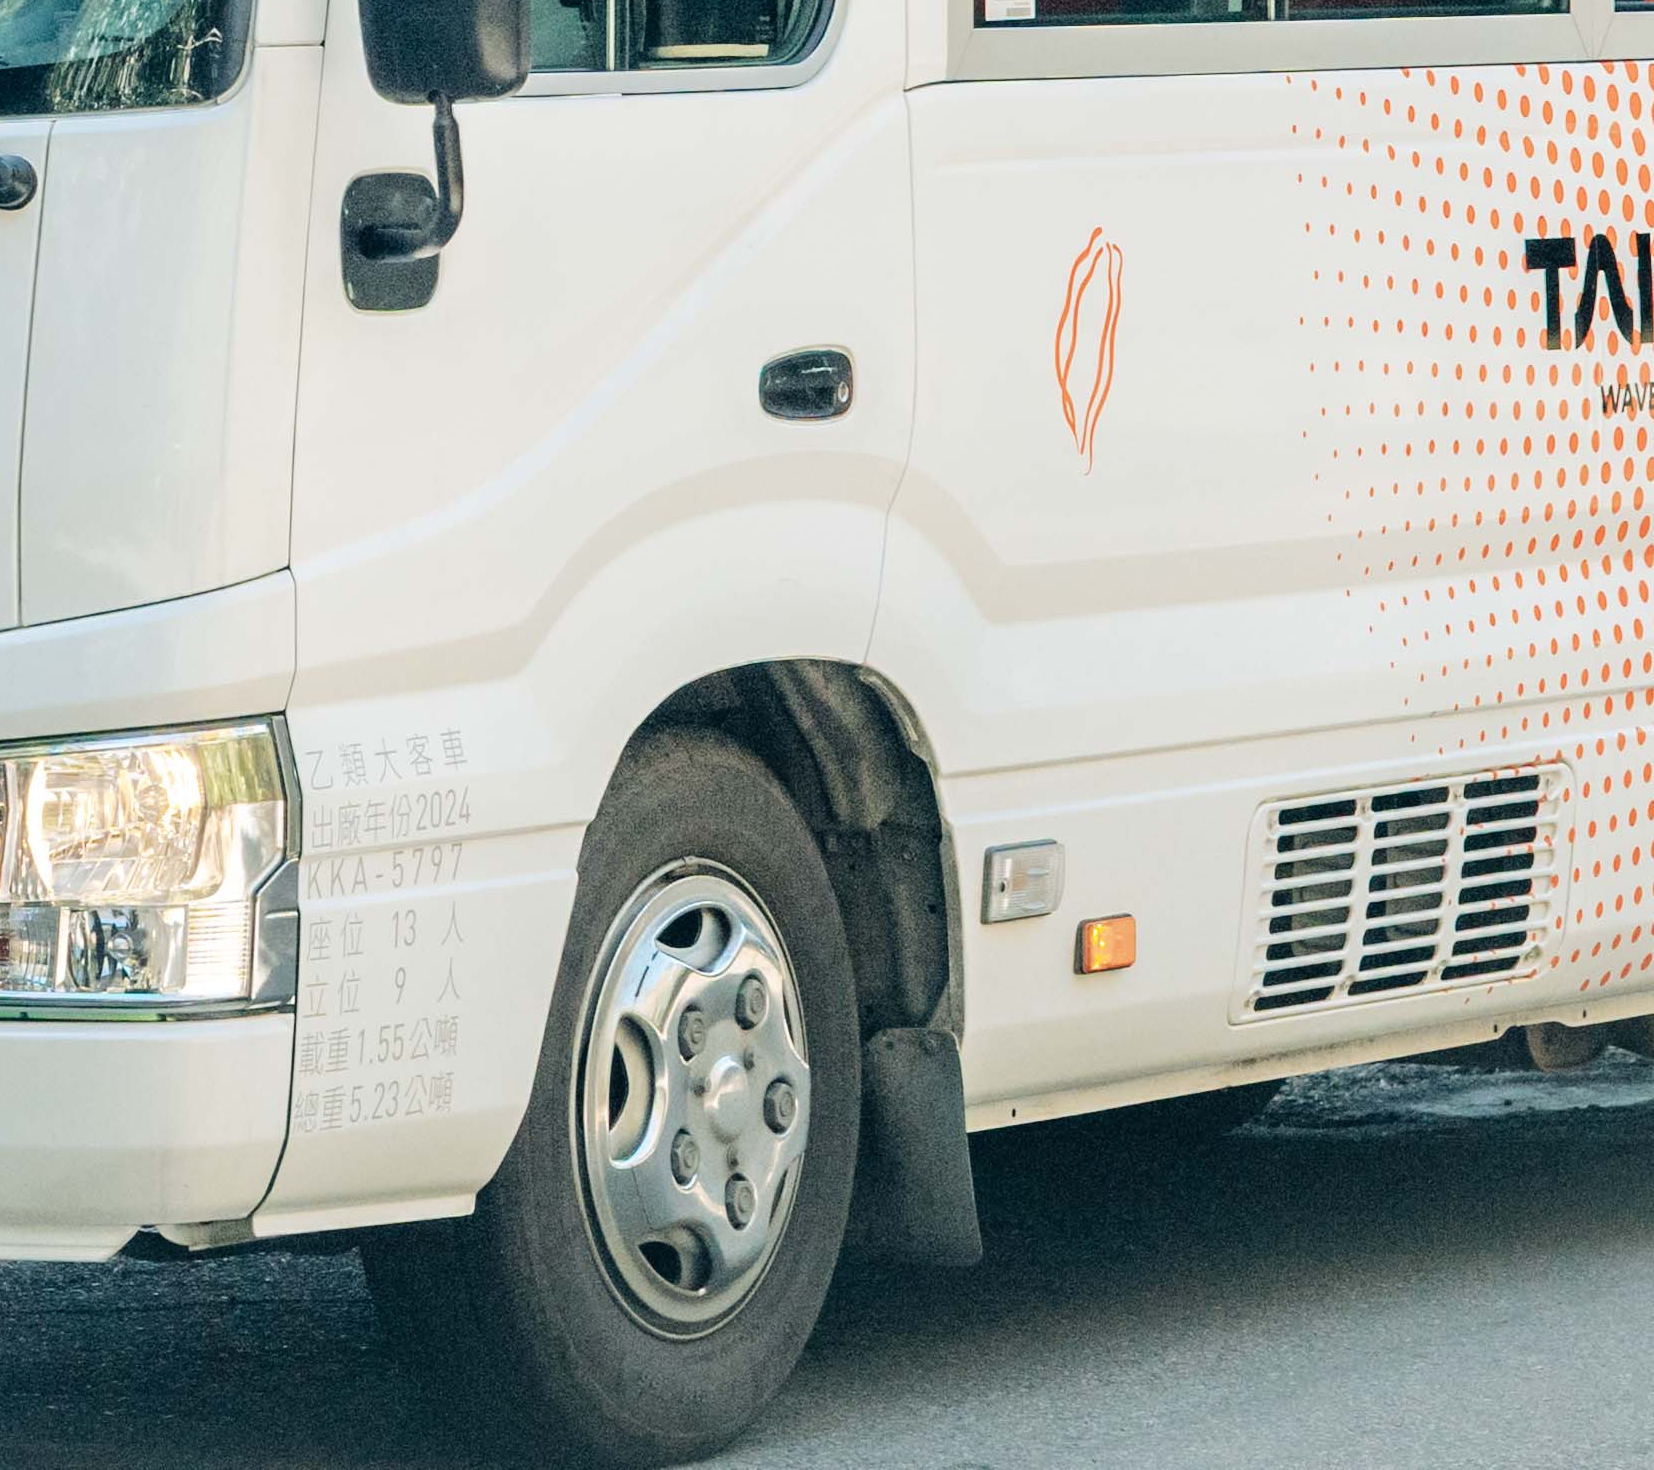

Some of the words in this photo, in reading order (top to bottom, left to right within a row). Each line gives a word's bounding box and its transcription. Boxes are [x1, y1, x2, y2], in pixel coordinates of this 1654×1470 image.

[304, 727, 468, 791] 乙類大客車
[308, 843, 463, 901] KKA-5797
[392, 908, 417, 949] 13
